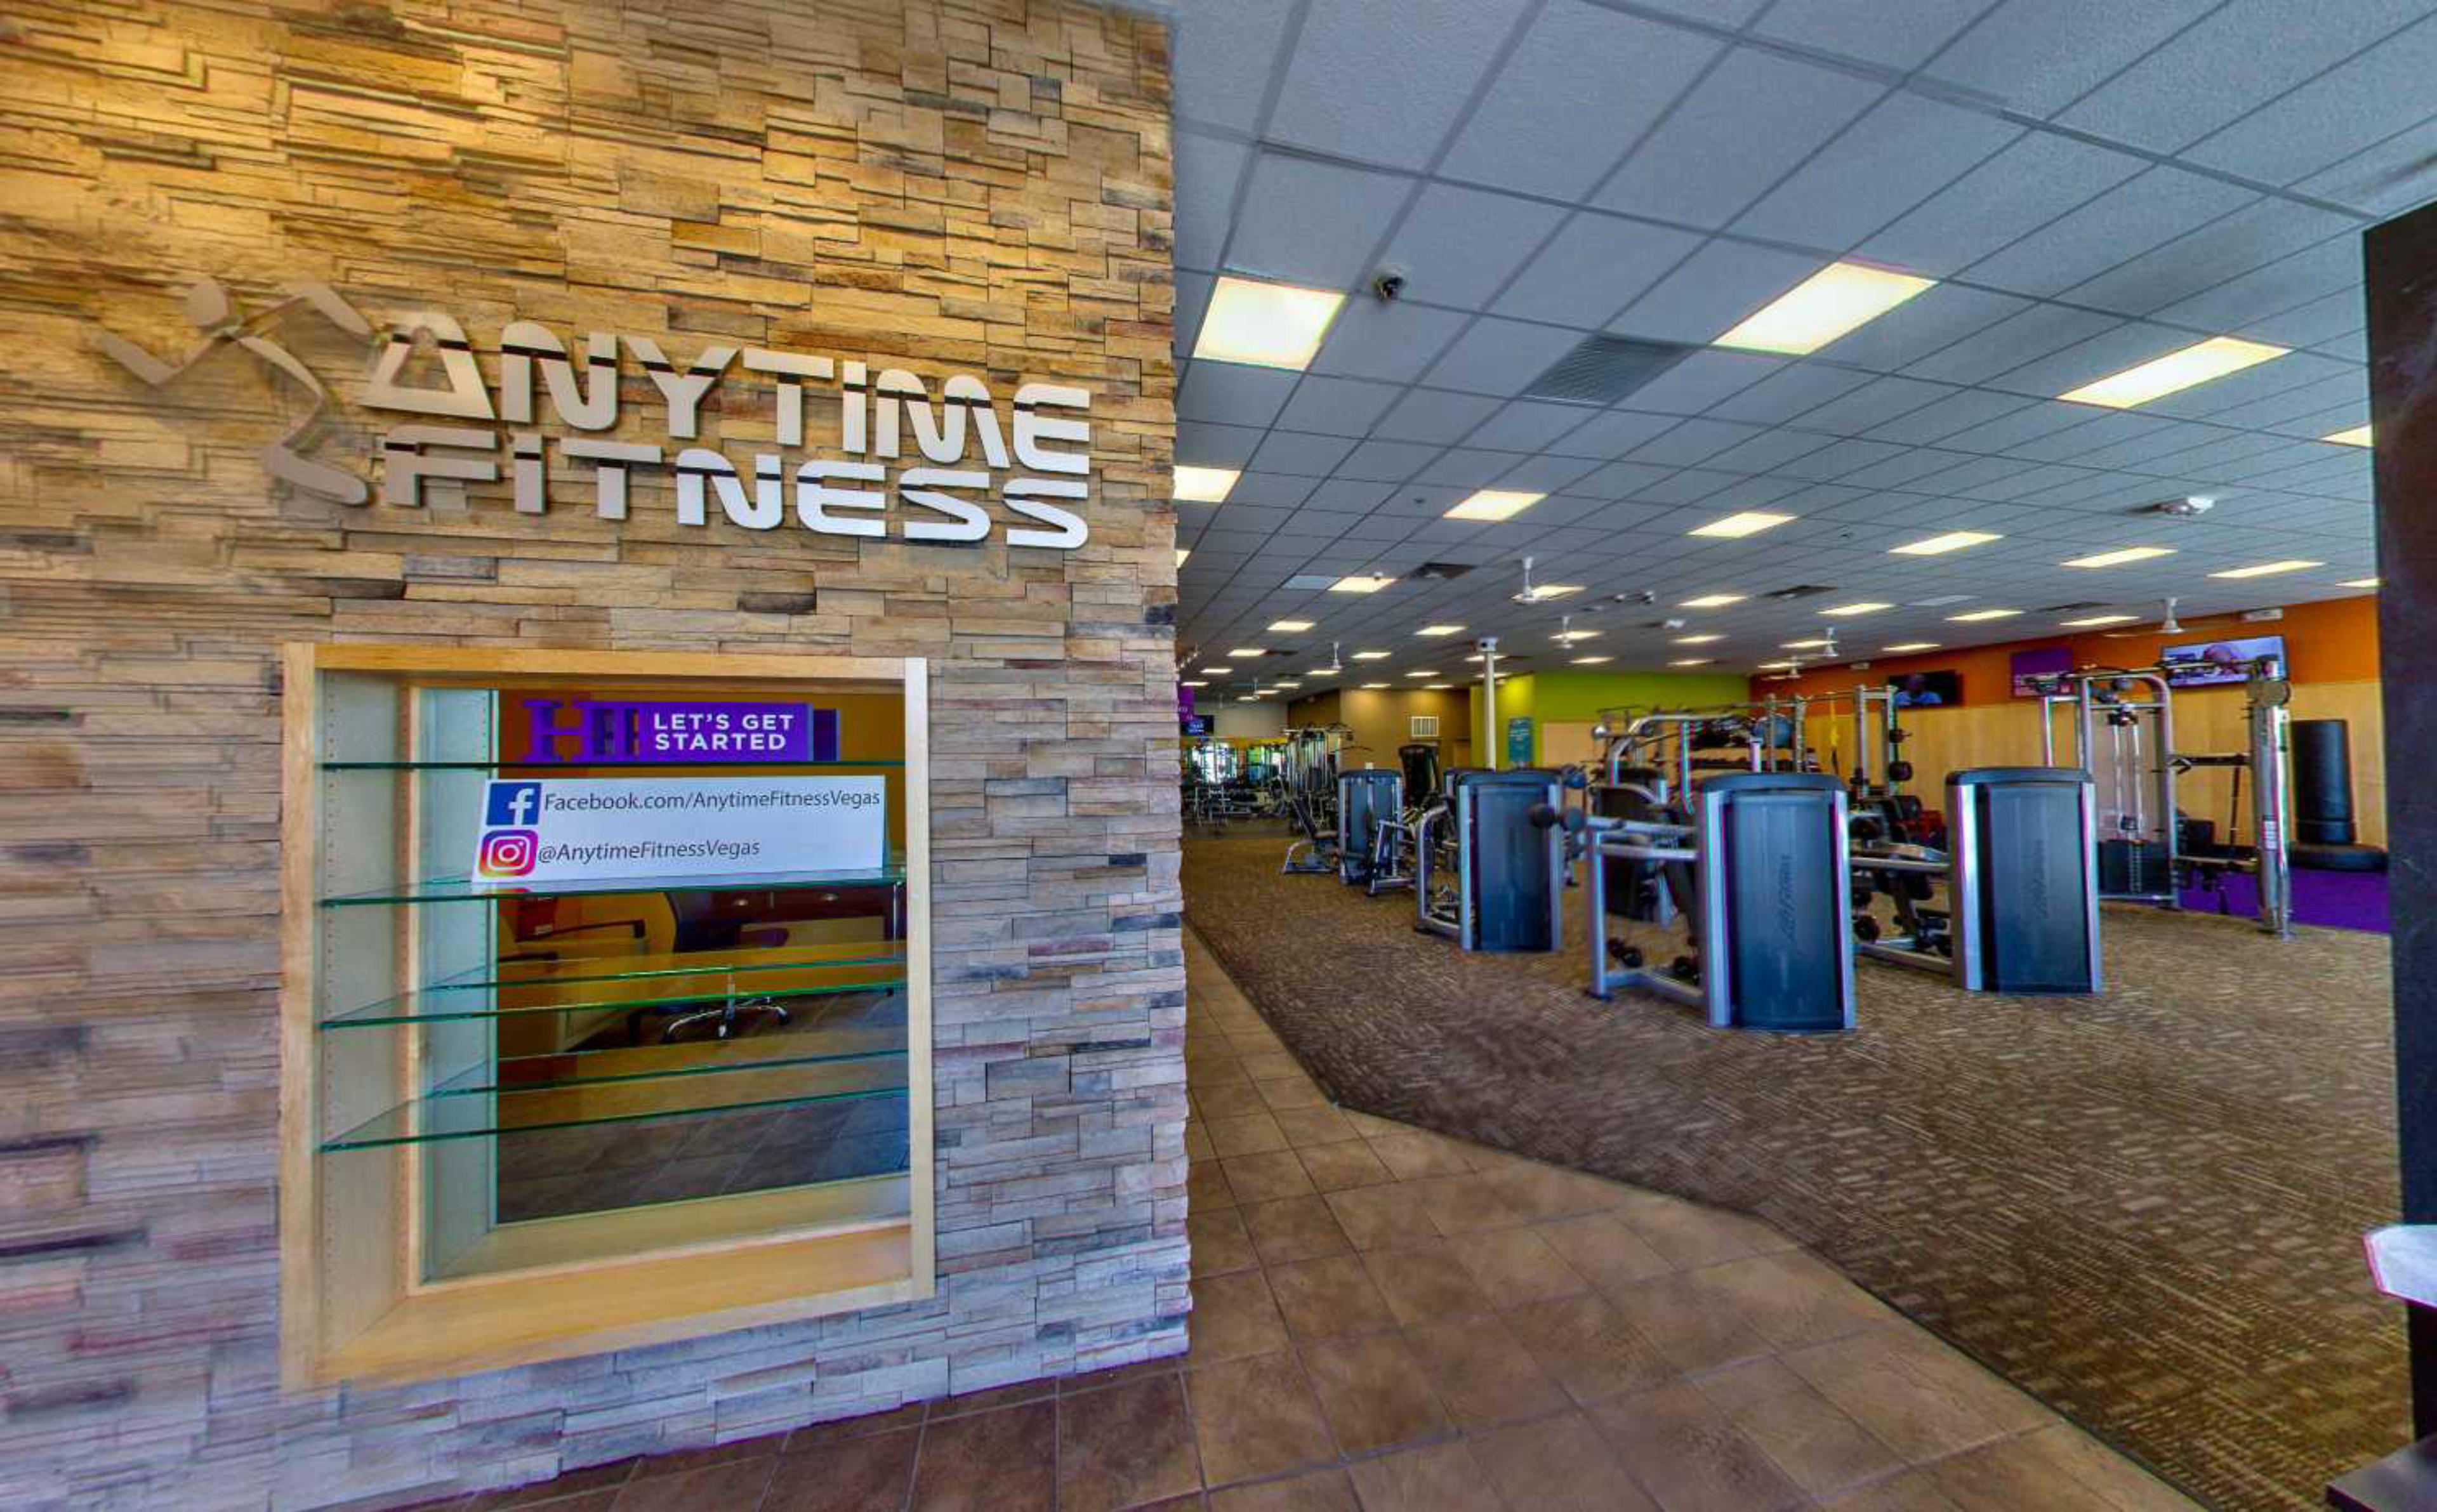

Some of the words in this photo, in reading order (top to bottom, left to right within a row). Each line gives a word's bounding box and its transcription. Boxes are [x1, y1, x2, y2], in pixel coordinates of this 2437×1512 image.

[357, 312, 1090, 475] ANYTIME
[383, 425, 1090, 549] FITNESS
[654, 713, 730, 730] LET'S
[742, 714, 794, 730] GET
[655, 733, 786, 751] STARTED
[545, 791, 880, 811] Facebook.com/AnytimeFitnessVegas
[539, 839, 760, 864] @AnytimeFitnessVegas
